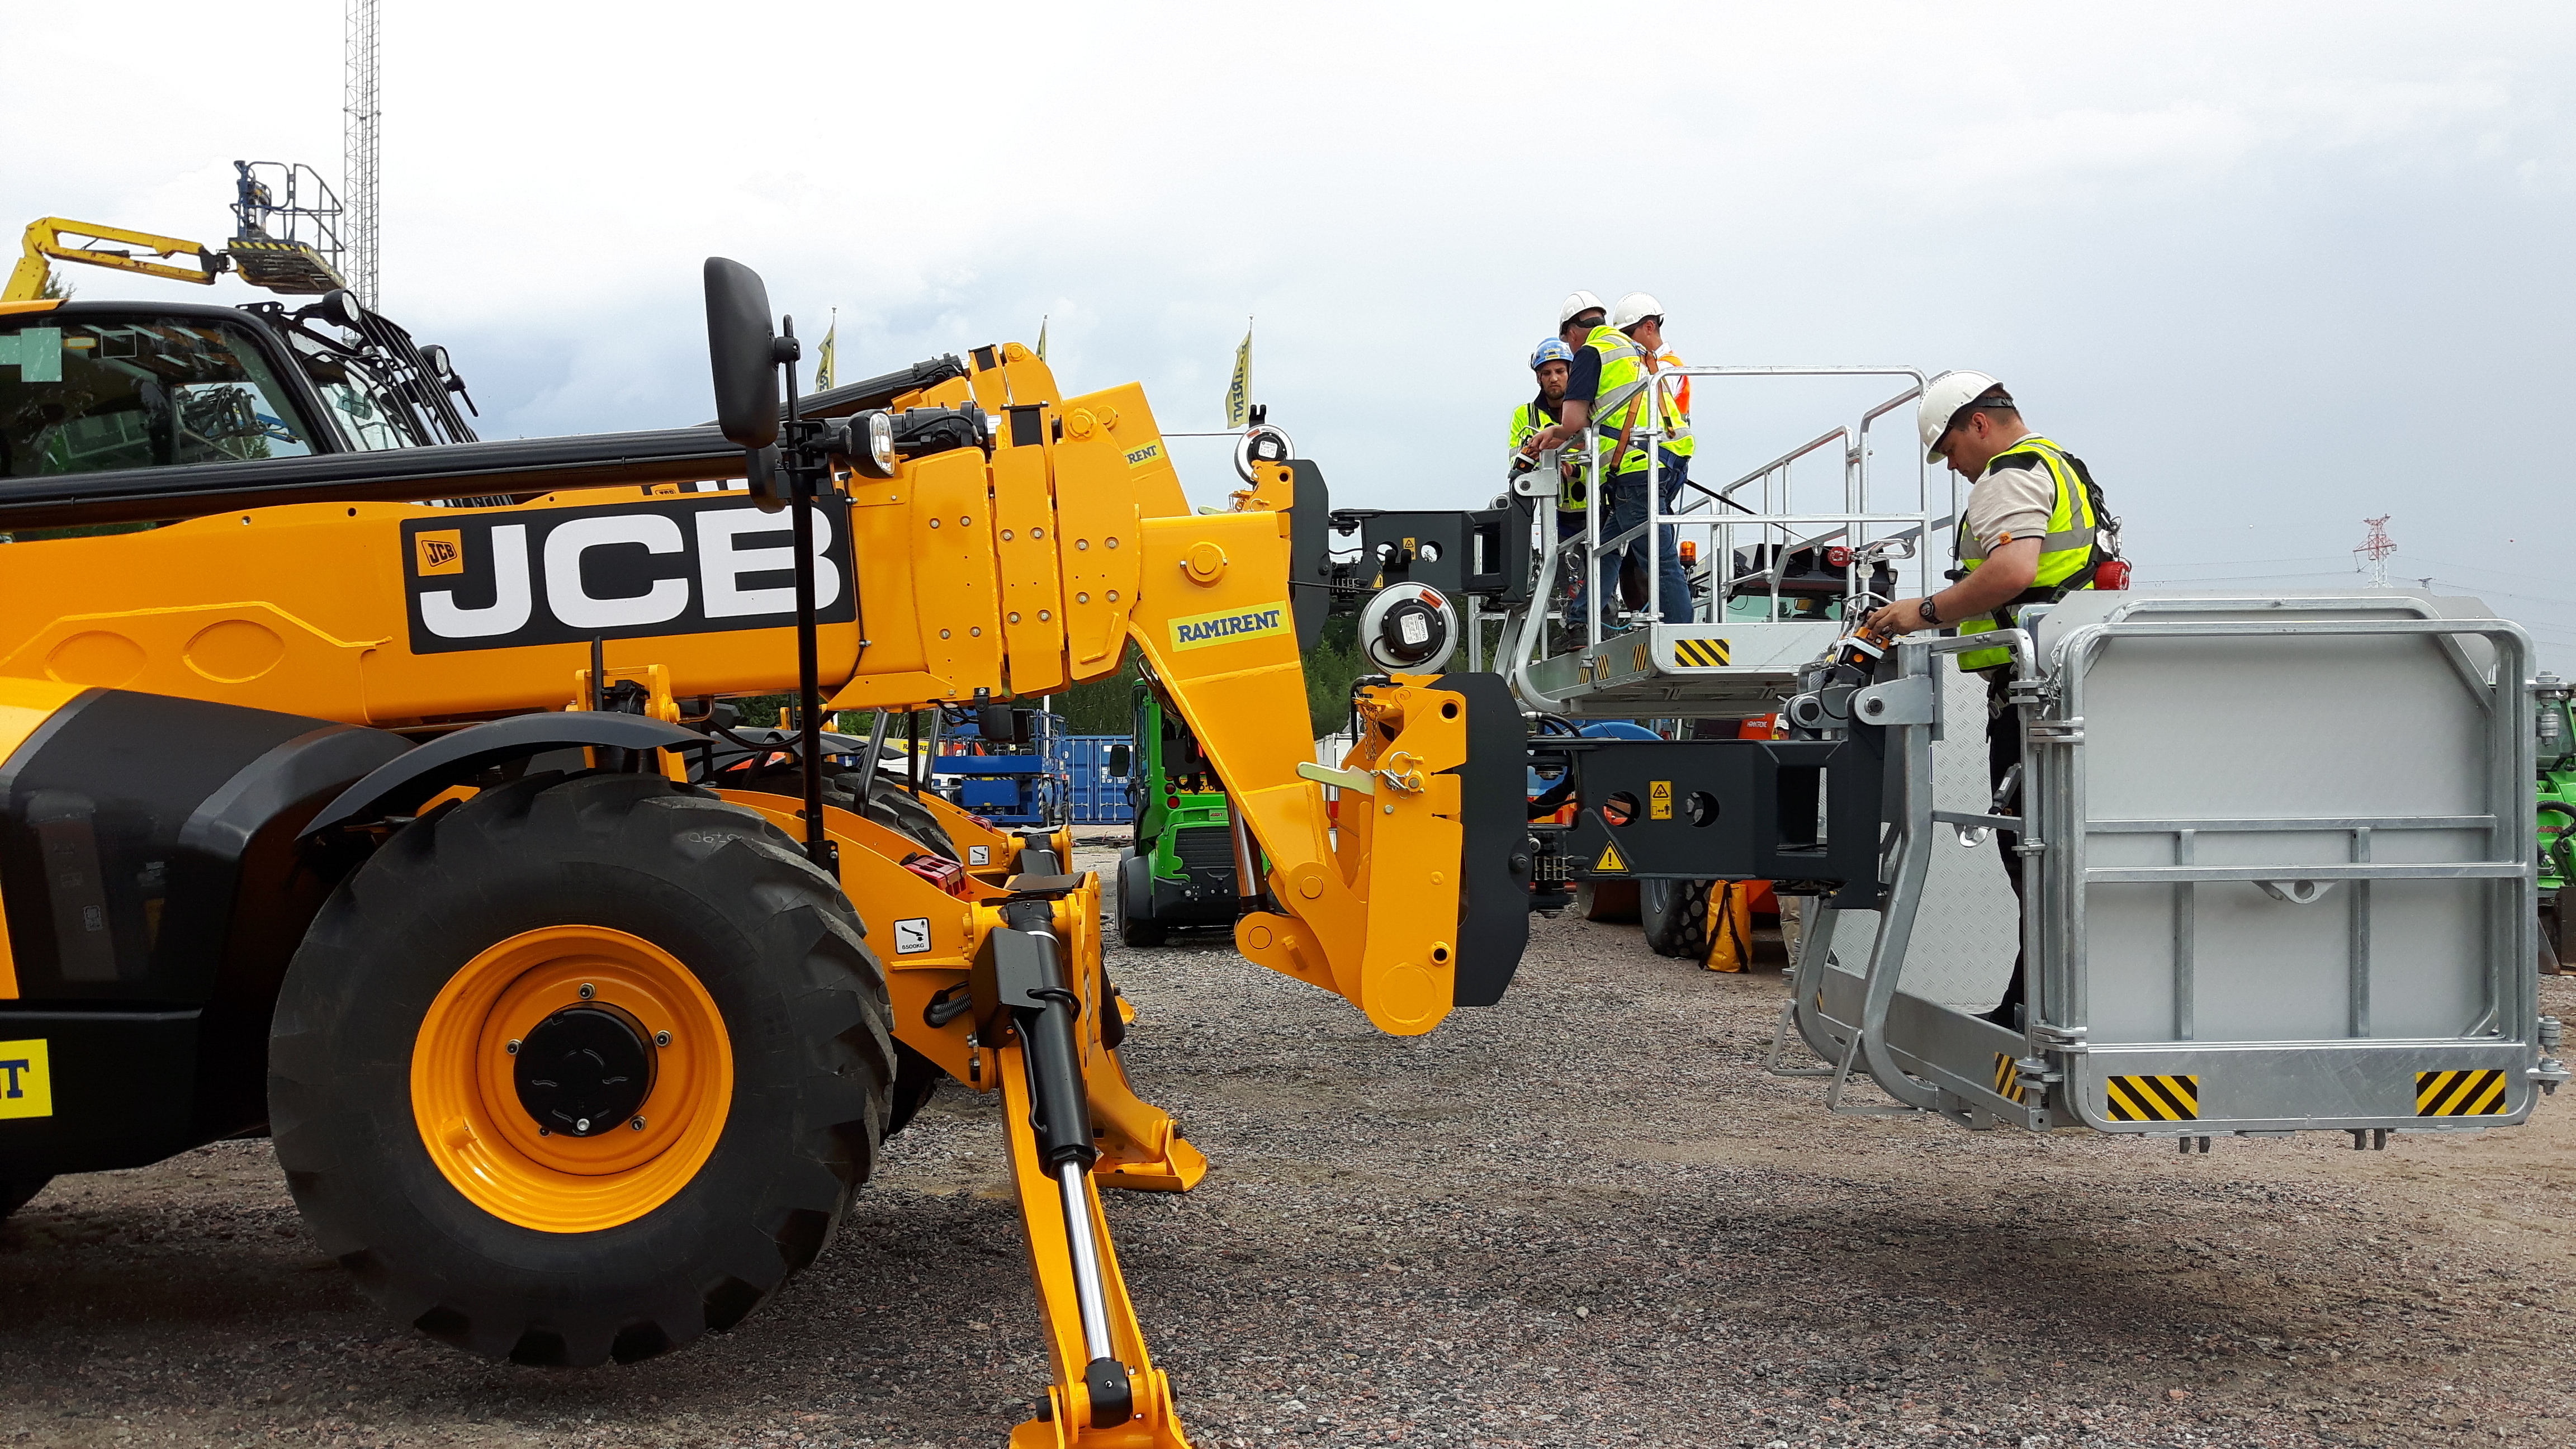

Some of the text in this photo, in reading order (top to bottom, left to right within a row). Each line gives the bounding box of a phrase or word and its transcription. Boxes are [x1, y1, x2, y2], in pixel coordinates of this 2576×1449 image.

[1125, 445, 1157, 464] RENT
[428, 543, 455, 564] JCB
[420, 505, 840, 638] JCB
[1177, 610, 1280, 642] RAMIRENT
[0, 1059, 30, 1099] T
